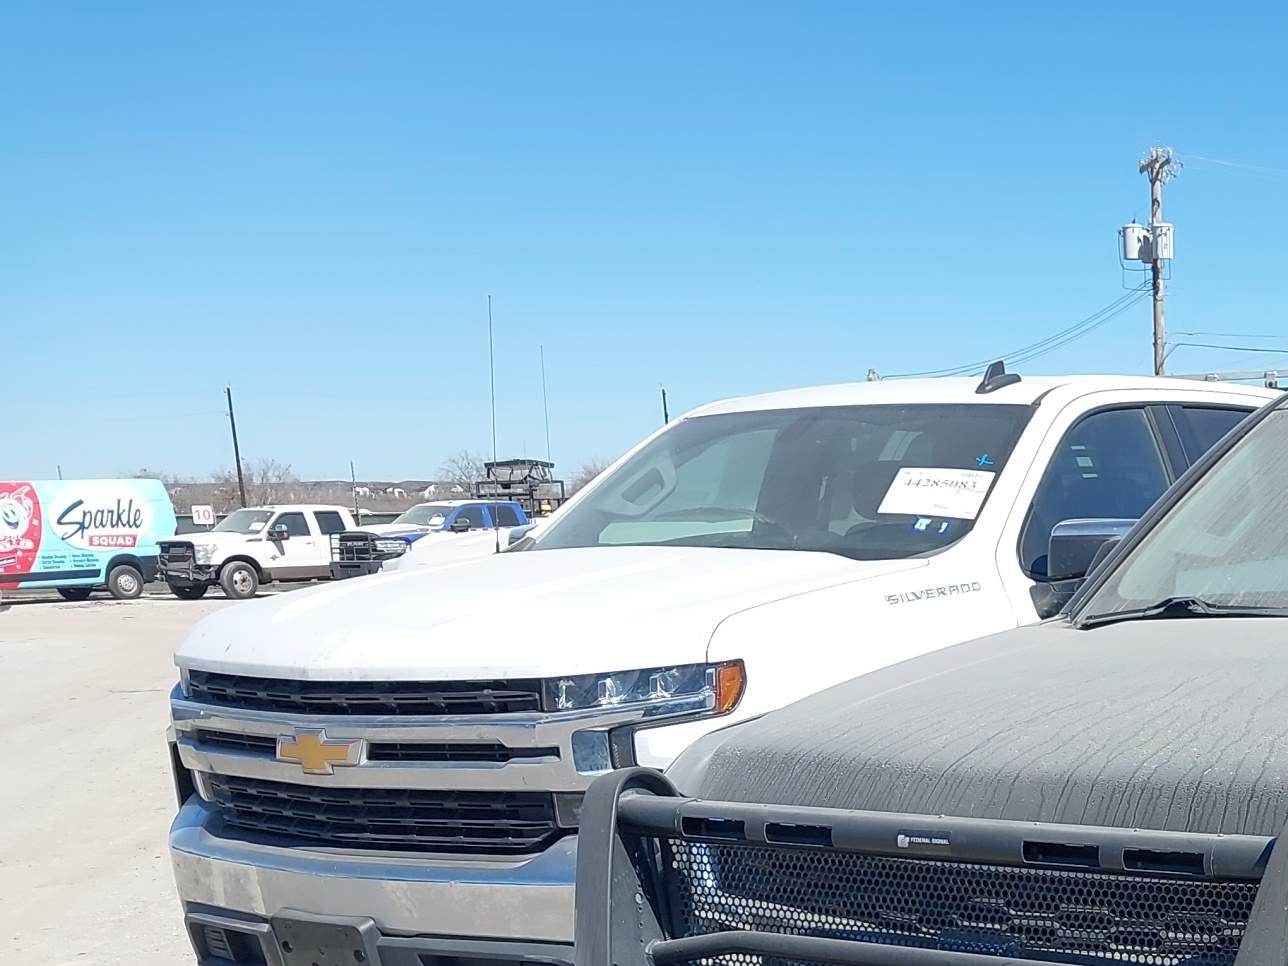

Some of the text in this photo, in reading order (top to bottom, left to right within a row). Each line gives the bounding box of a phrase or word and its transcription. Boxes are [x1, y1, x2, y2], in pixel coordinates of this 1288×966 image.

[903, 478, 977, 489] 44285083
[56, 499, 143, 540] Sparkle
[194, 510, 210, 521] 10
[92, 535, 133, 545] SQUAD
[884, 581, 982, 605] SILVERADO
